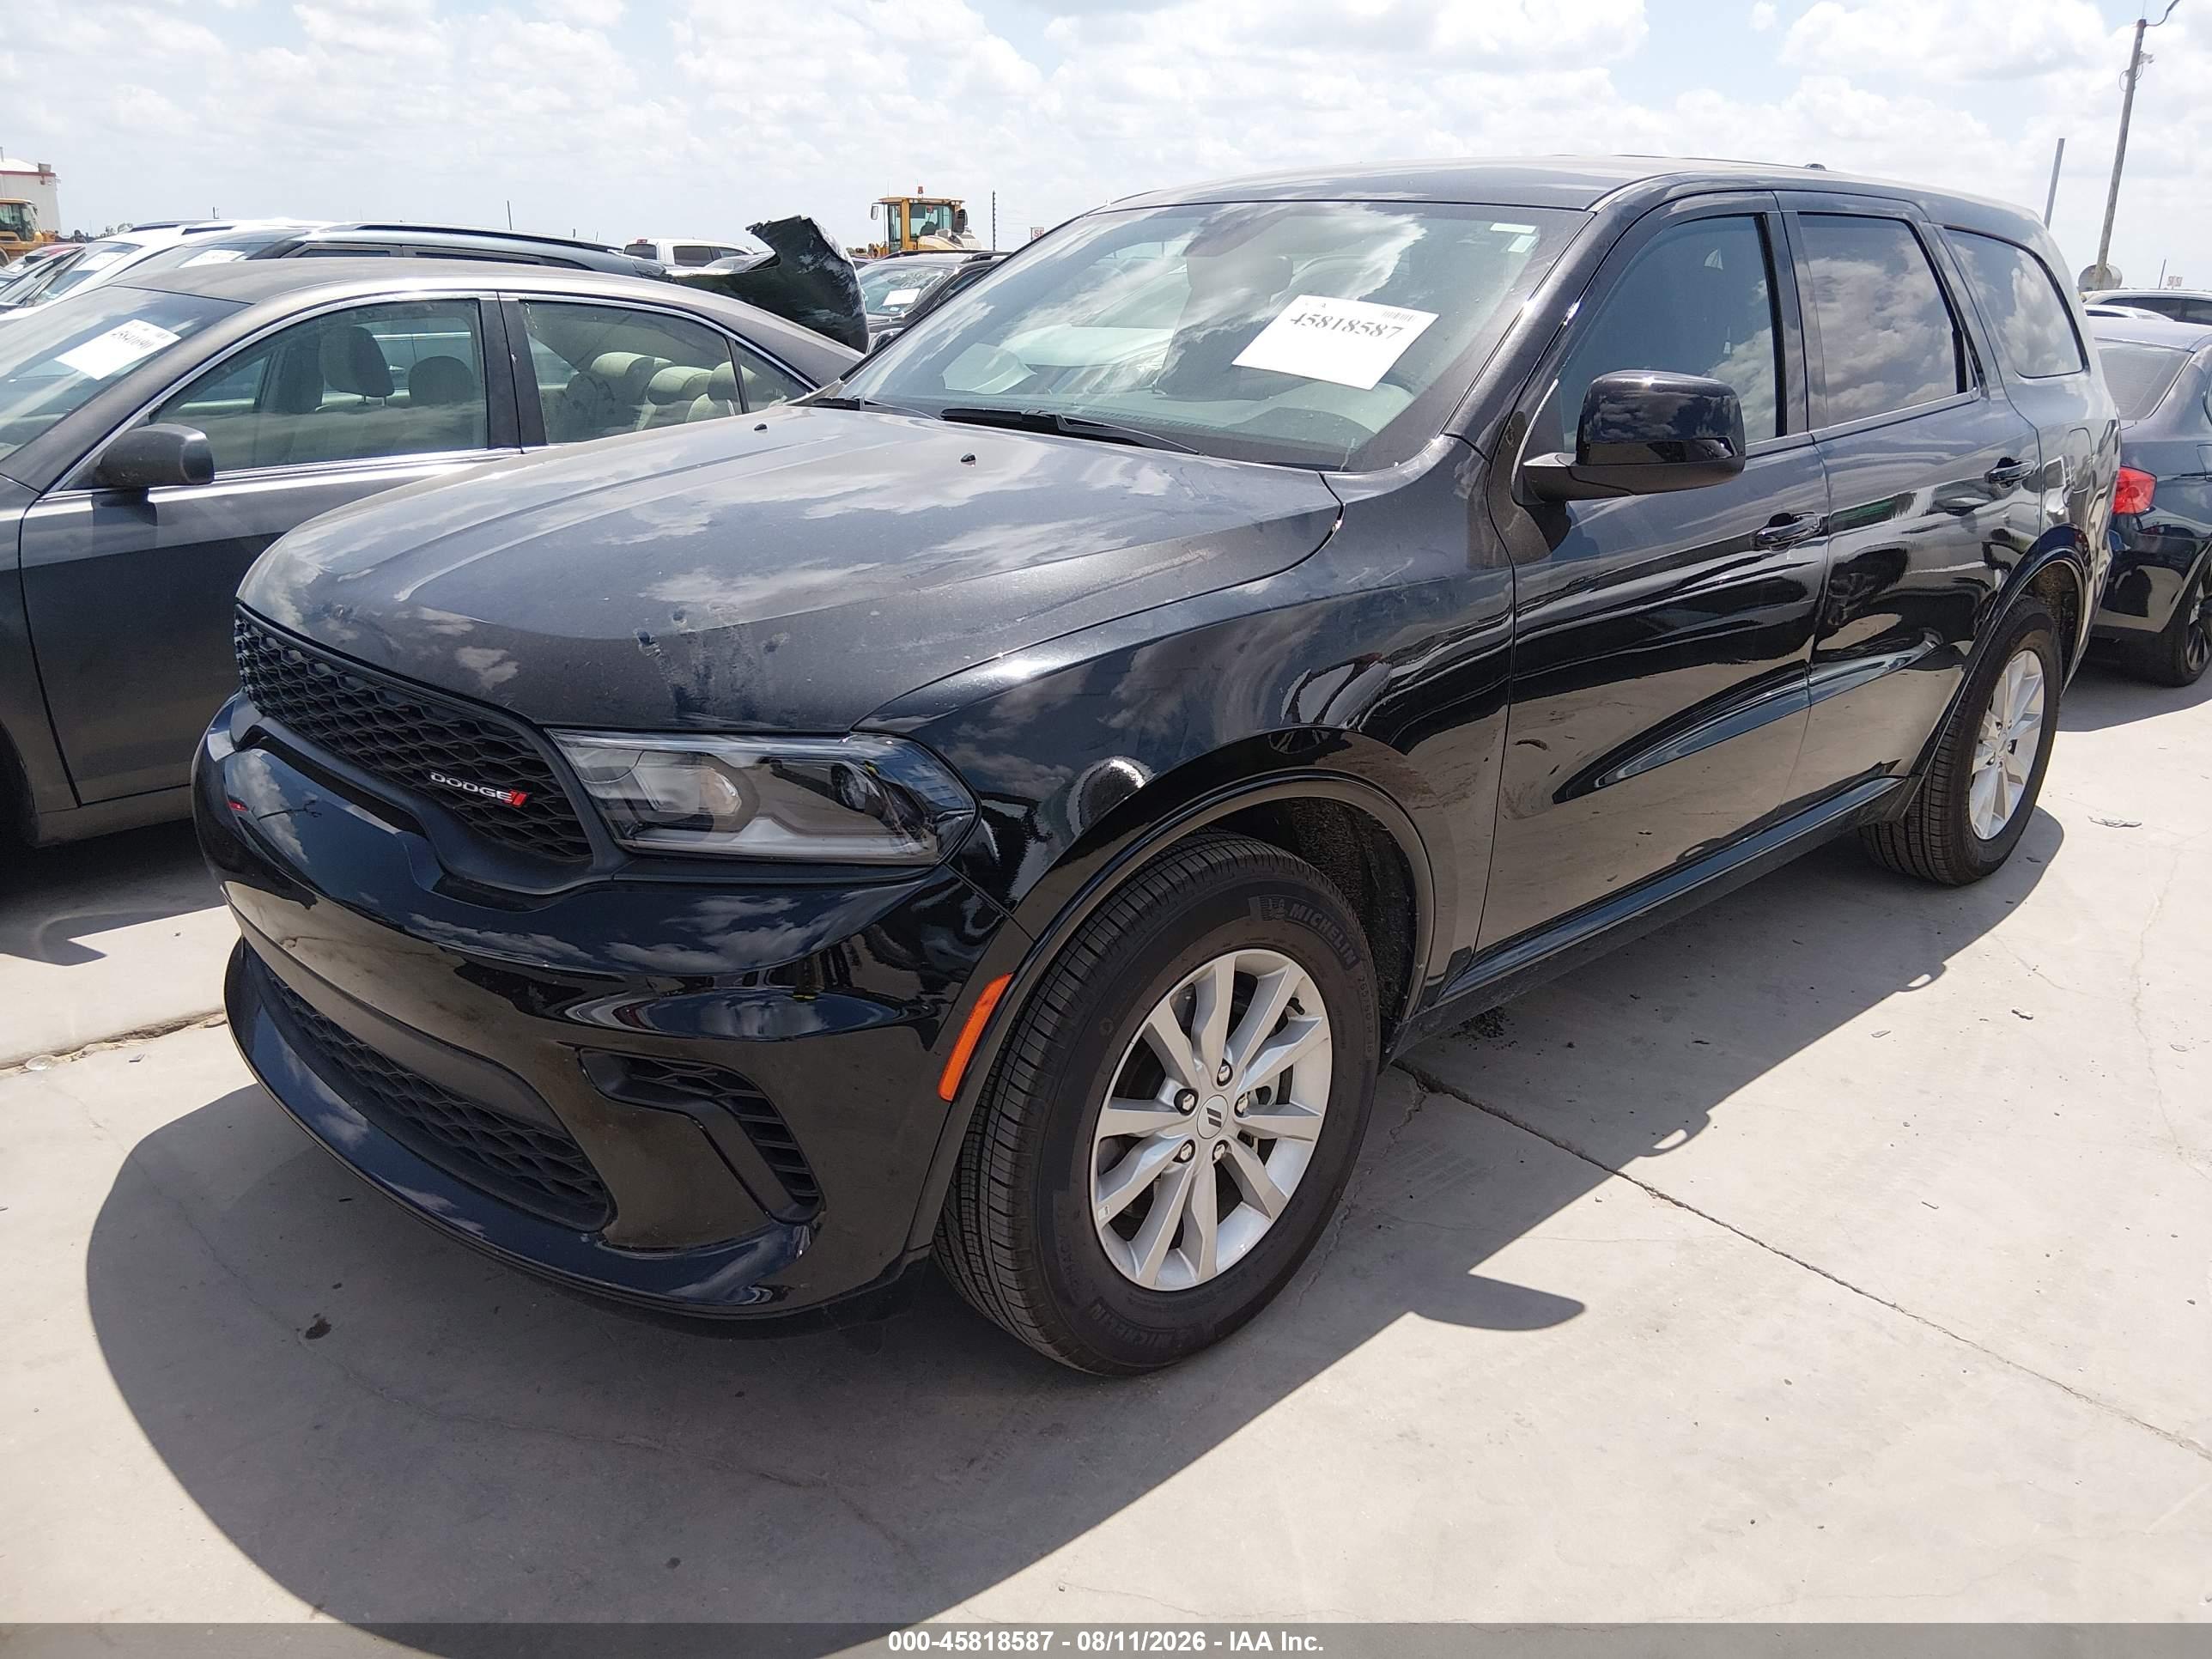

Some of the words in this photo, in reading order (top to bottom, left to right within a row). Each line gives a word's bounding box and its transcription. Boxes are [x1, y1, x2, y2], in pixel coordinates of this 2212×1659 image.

[1290, 313, 1404, 340] 45818587
[429, 771, 514, 803] DODGE
[1289, 902, 1358, 966] MICHELIN
